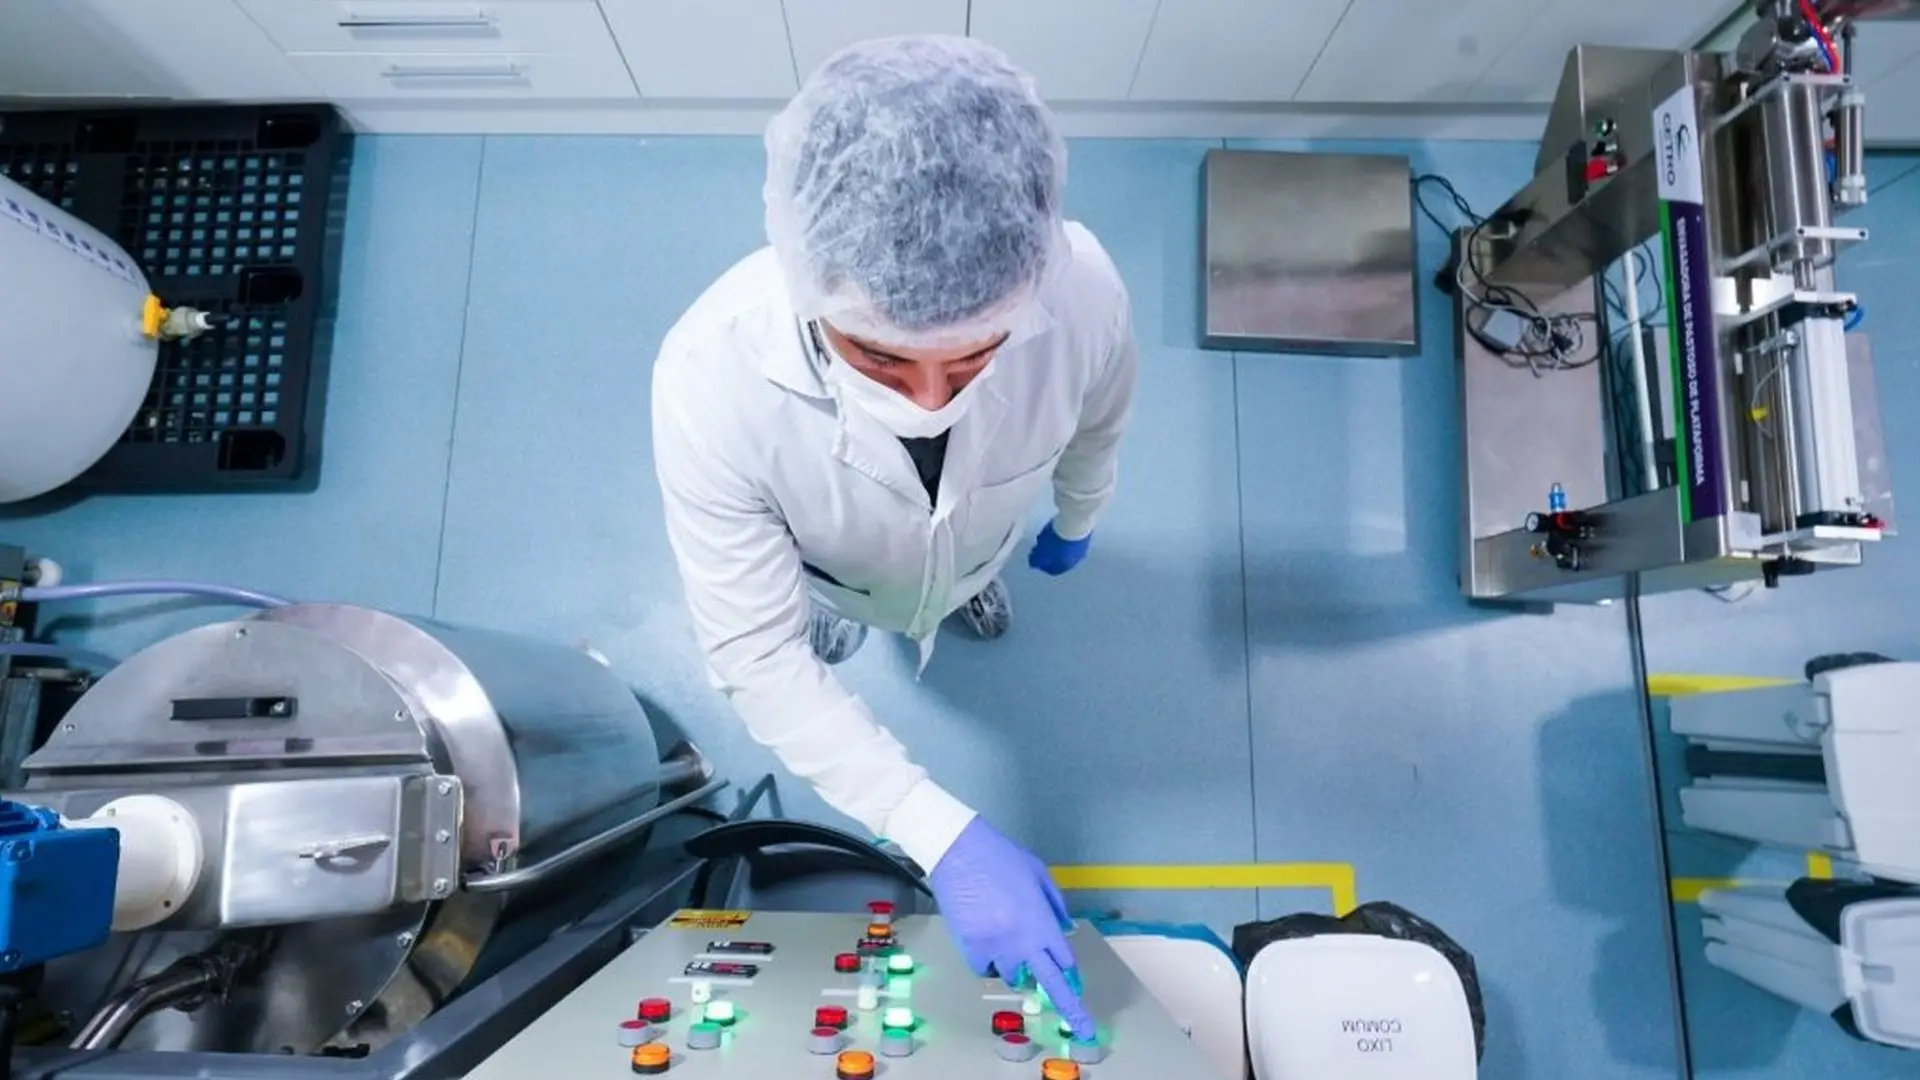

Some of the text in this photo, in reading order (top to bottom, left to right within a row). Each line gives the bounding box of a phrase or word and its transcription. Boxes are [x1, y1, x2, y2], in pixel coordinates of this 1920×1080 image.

[1663, 112, 1676, 187] CETRO
[1683, 301, 1693, 321] DE
[1685, 321, 1697, 379] PASTOSO
[1688, 379, 1698, 399] DE
[1690, 399, 1705, 486] PLATAFORMA
[1341, 1018, 1402, 1033] COMUM
[1357, 1038, 1392, 1053] LIXO
